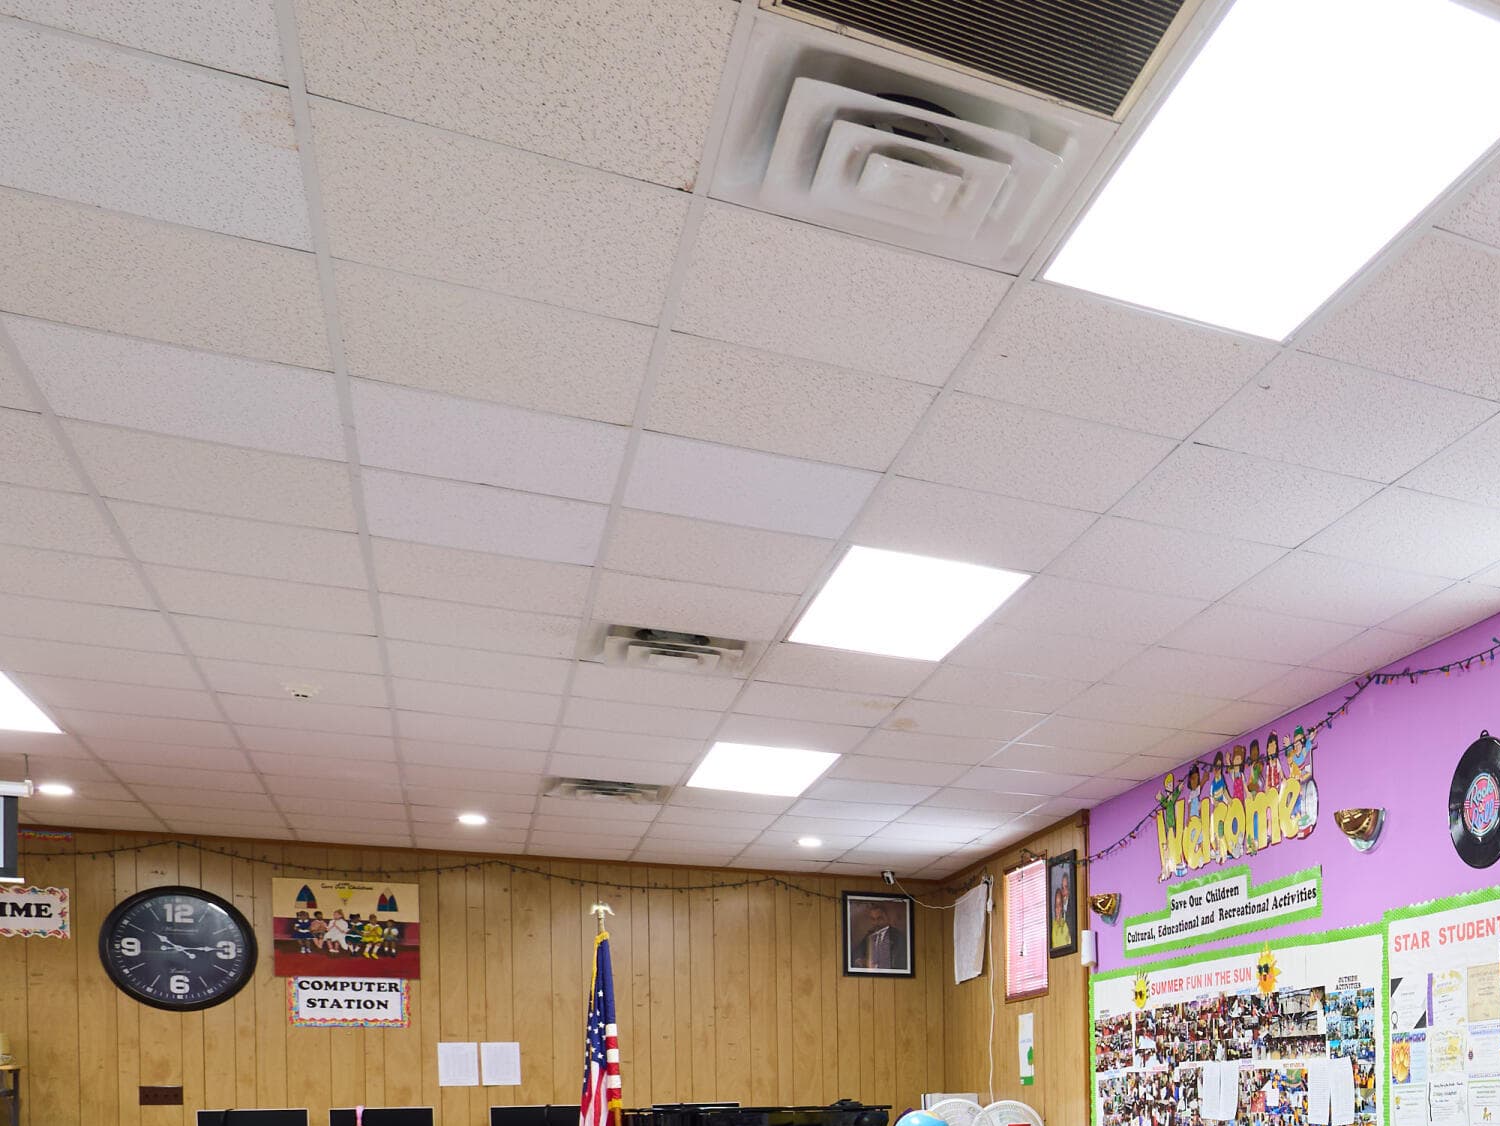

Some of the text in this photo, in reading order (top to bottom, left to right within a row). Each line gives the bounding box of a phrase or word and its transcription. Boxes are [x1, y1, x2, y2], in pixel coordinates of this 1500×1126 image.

[1470, 774, 1494, 808] Rock
[1157, 778, 1302, 869] Welcome
[1471, 799, 1494, 833] Roll
[1171, 885, 1239, 912] Save Our Children
[164, 904, 194, 923] 12
[1128, 887, 1317, 943] Cultural, Educational and Recreational Activities
[121, 937, 237, 960] 9 3
[1394, 930, 1430, 952] STAR
[170, 975, 190, 994] 6
[298, 980, 401, 993] COMPUTER
[1151, 967, 1252, 996] SUMMER FUN IN THE SUN
[306, 998, 389, 1010] STATION
